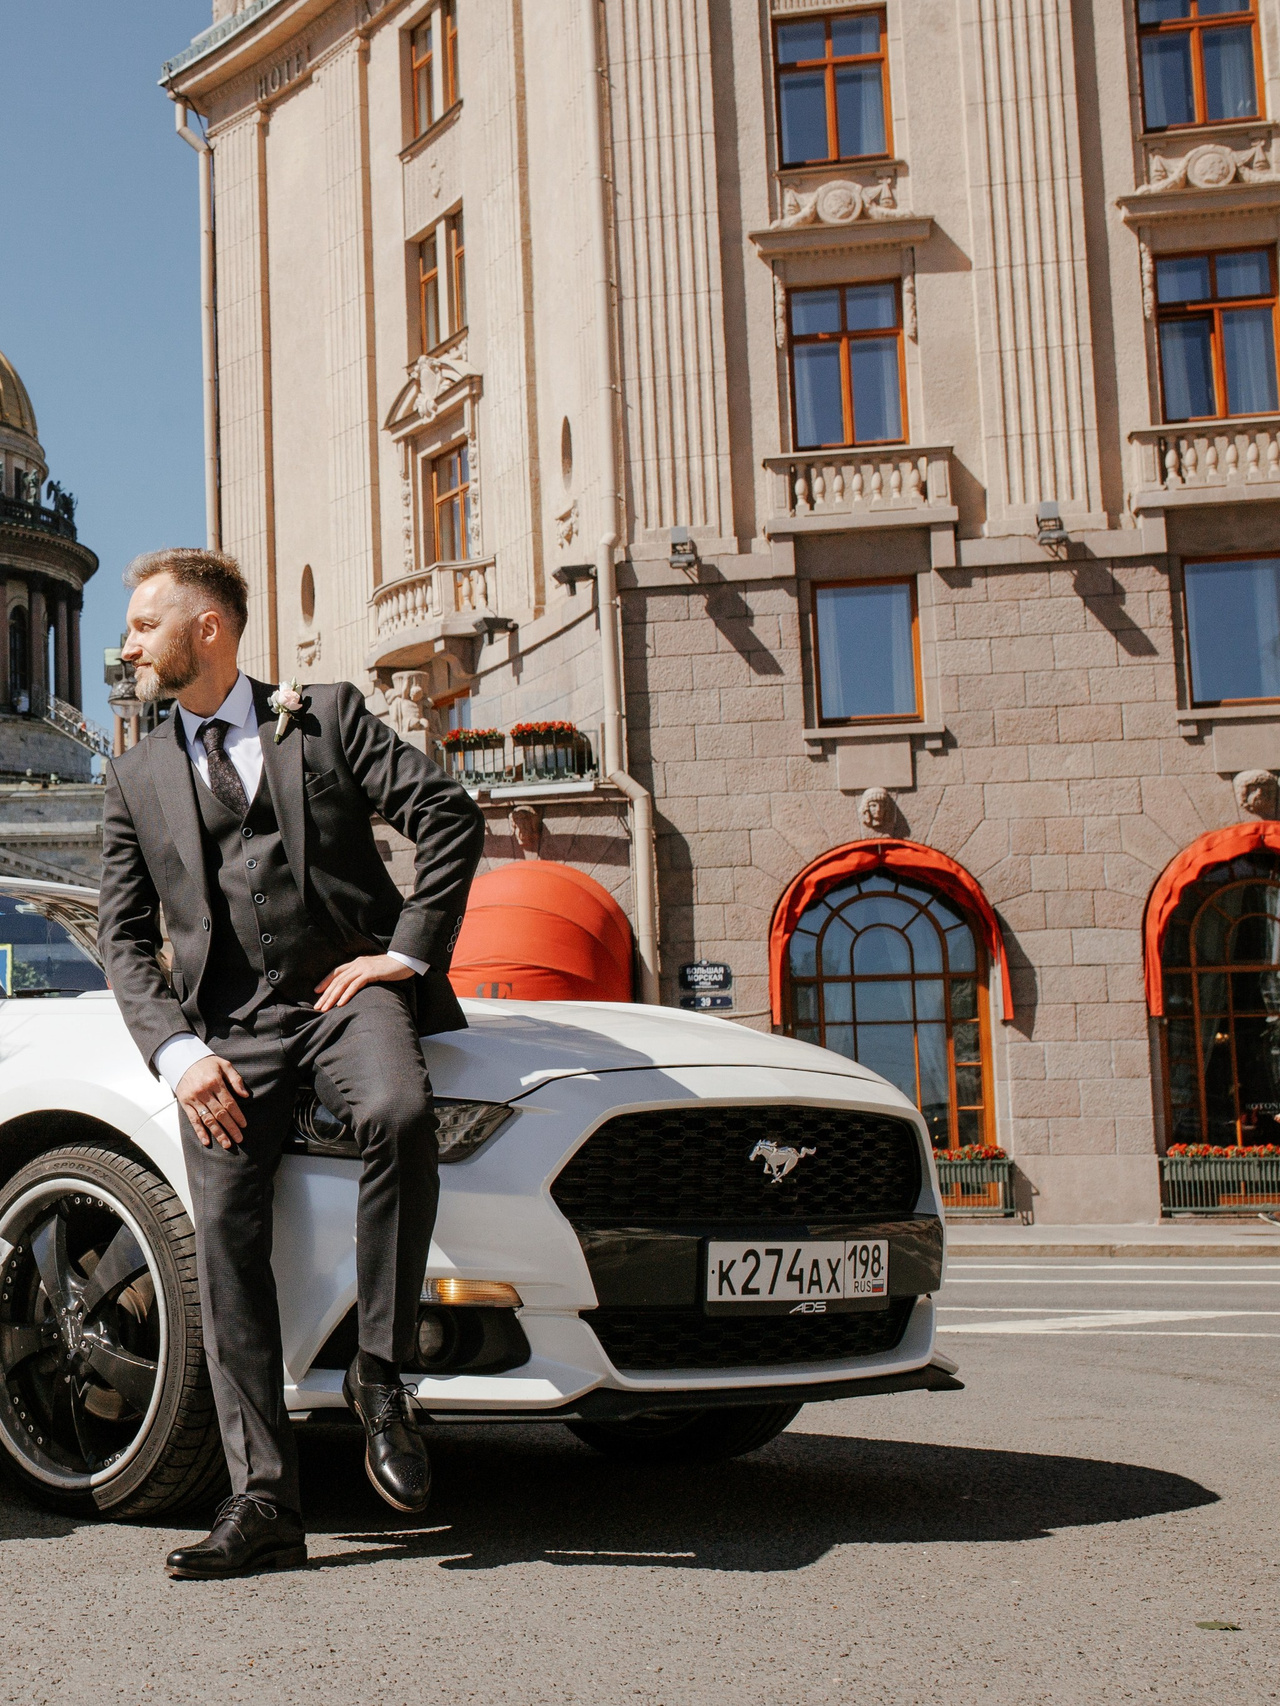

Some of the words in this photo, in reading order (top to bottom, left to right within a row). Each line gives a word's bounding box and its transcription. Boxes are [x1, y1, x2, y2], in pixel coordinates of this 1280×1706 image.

[686, 966, 724, 975] БОЛЬШАЯ
[687, 974, 723, 982] МОРСКАЯ
[700, 997, 711, 1007] 39
[52, 1162, 109, 1180] SPORTEX
[847, 1244, 882, 1279] 198
[853, 1280, 872, 1293] RUS
[789, 1301, 827, 1314] ADS
